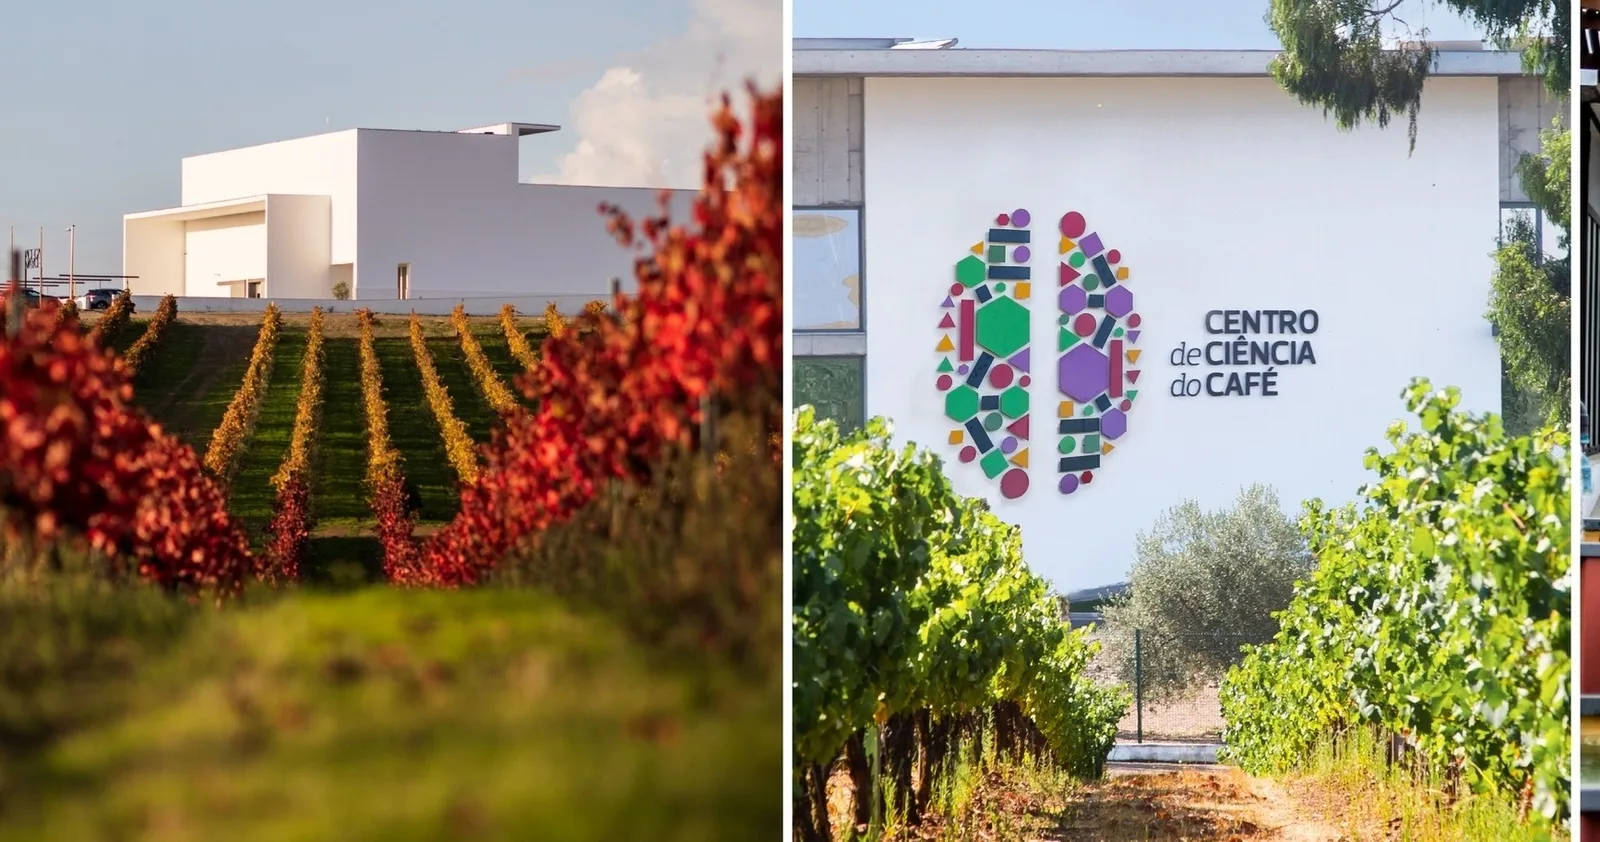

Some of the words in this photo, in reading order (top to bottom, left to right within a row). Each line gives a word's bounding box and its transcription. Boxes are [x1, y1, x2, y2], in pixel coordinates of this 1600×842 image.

[1205, 309, 1319, 335] CENTRO
[1170, 341, 1202, 367] de
[1205, 335, 1317, 366] CIÊNCIA
[1170, 372, 1202, 398] do
[1205, 367, 1279, 397] CAFÉ
